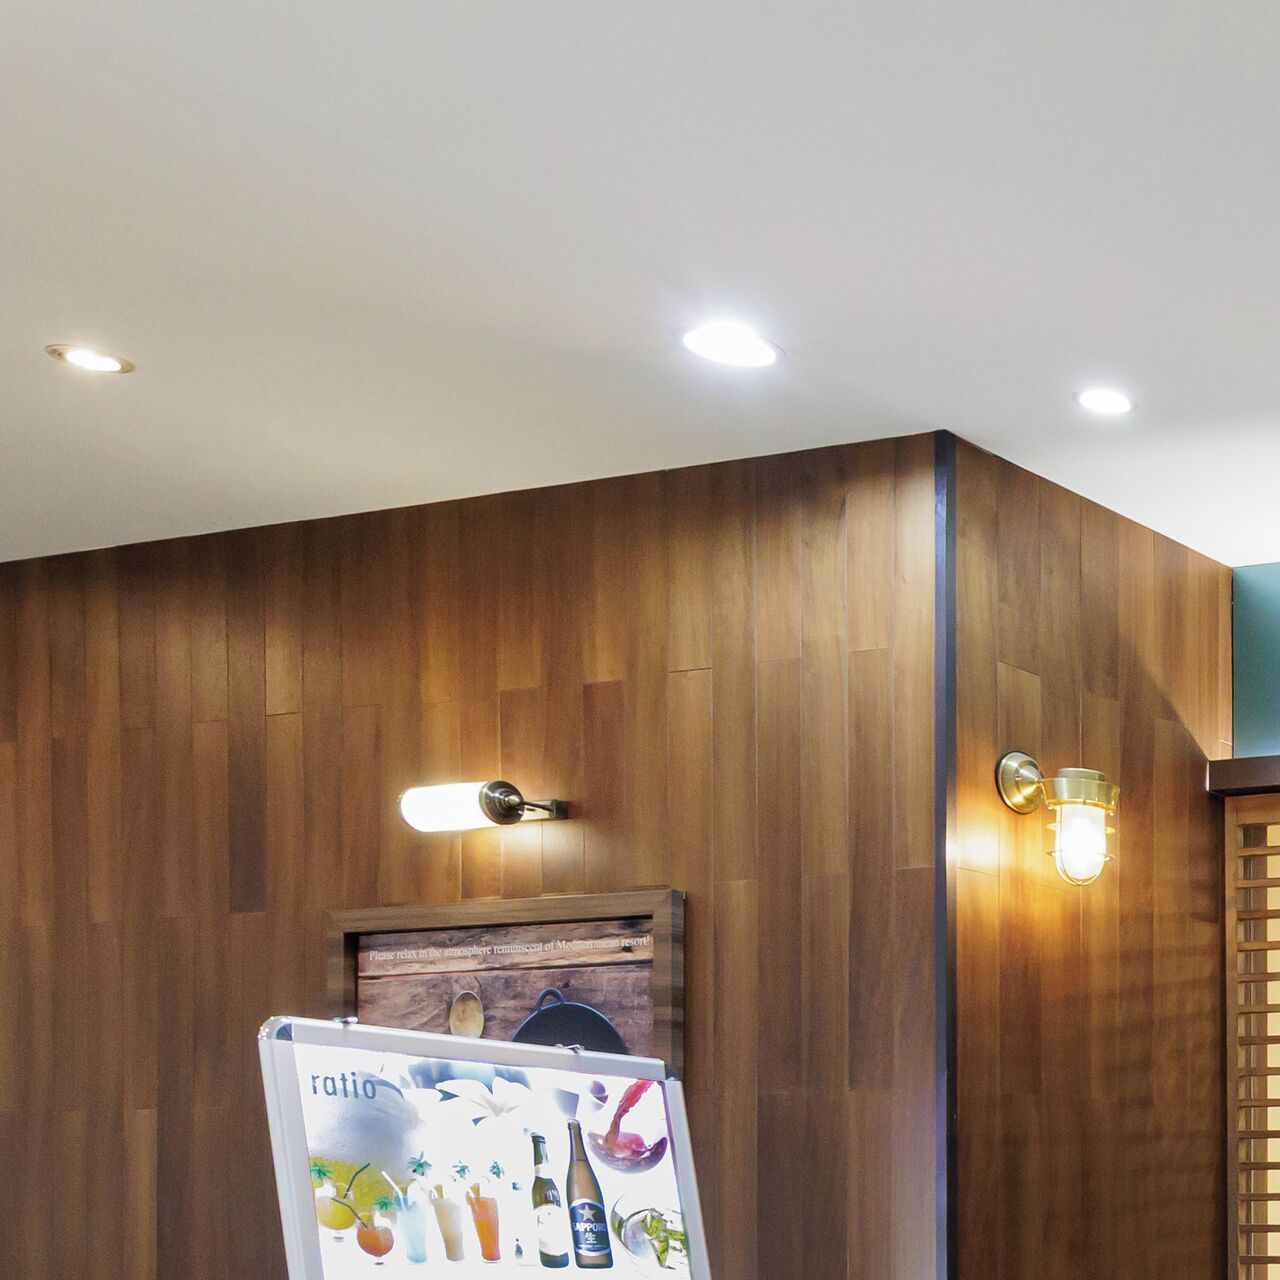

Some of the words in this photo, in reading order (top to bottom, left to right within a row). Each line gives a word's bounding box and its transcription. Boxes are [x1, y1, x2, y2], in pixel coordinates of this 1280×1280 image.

[369, 950, 395, 960] Please
[397, 948, 417, 959] relax
[419, 948, 428, 958] in
[429, 946, 441, 958] the
[444, 944, 492, 957] atmosphere
[493, 942, 542, 954] reminiscent
[544, 941, 554, 951] of
[311, 1071, 377, 1099] ratio
